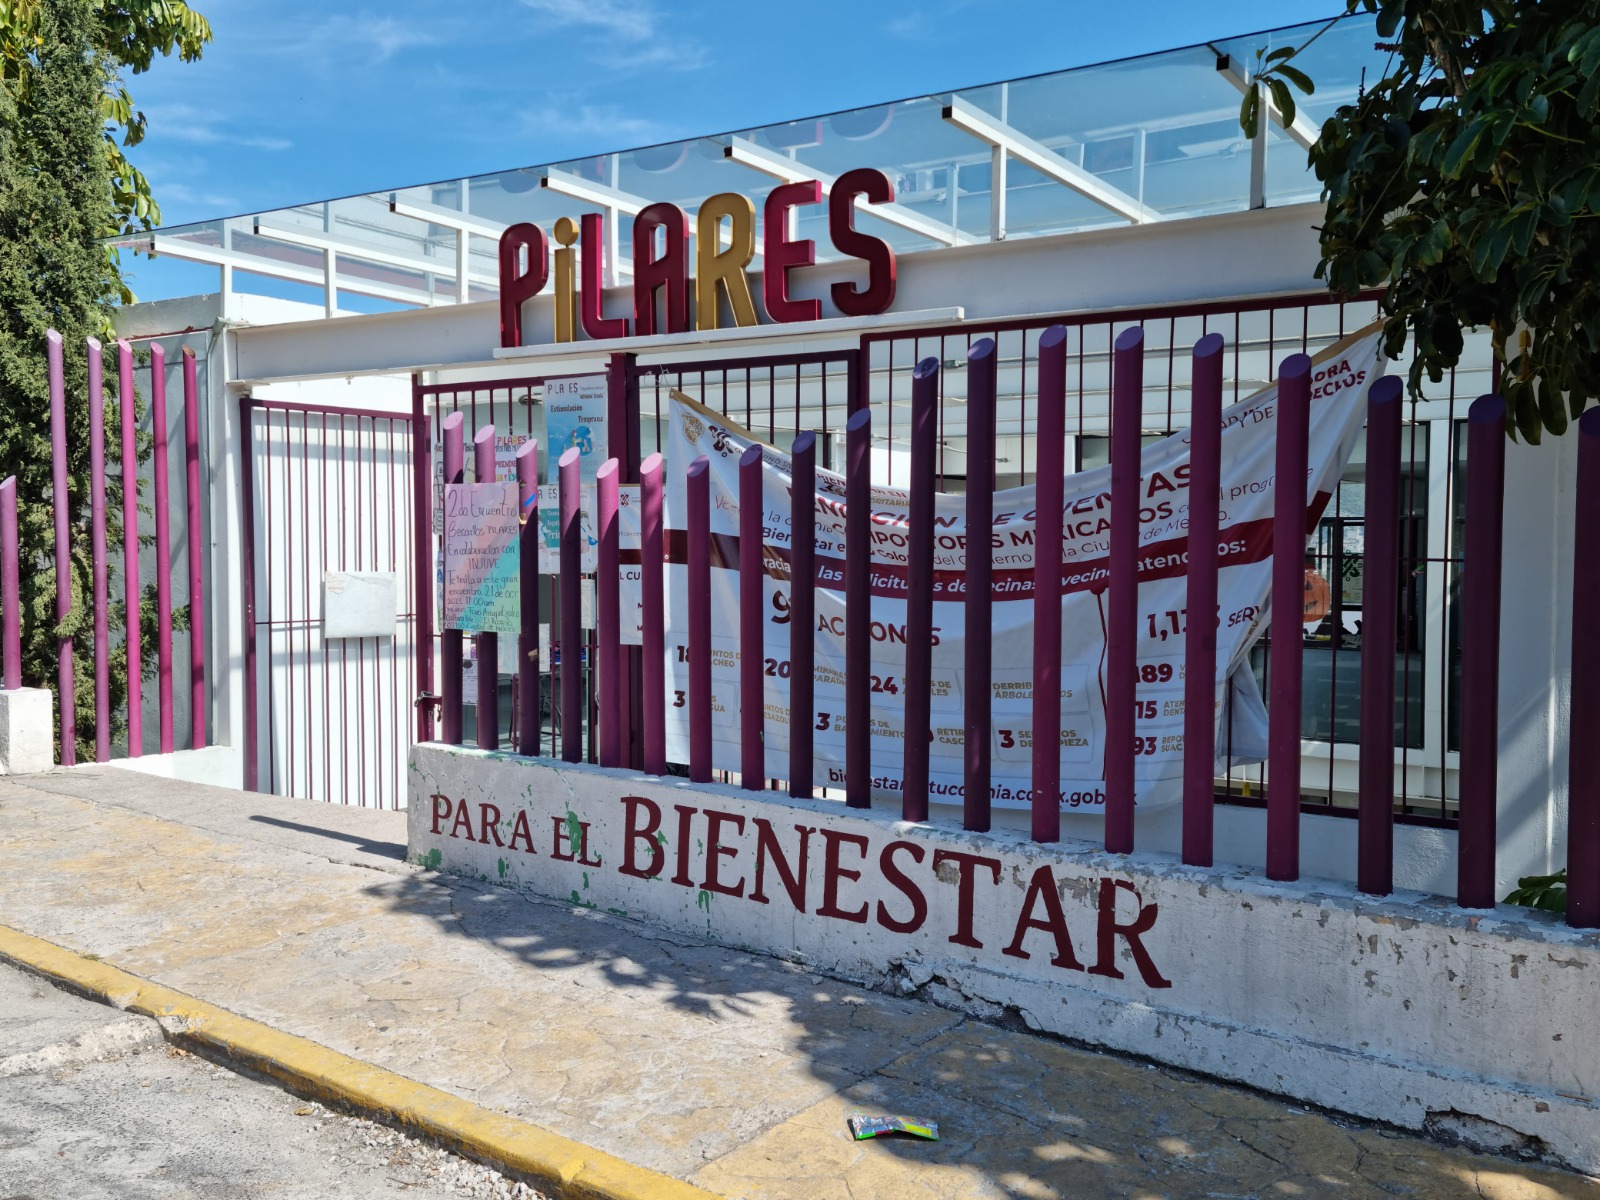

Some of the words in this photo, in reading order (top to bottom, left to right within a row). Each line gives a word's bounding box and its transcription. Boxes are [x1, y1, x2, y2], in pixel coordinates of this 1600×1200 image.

[817, 565, 843, 581] las
[430, 794, 538, 855] PARA
[550, 815, 602, 868] EL
[618, 796, 1173, 989] BIENESTAR
